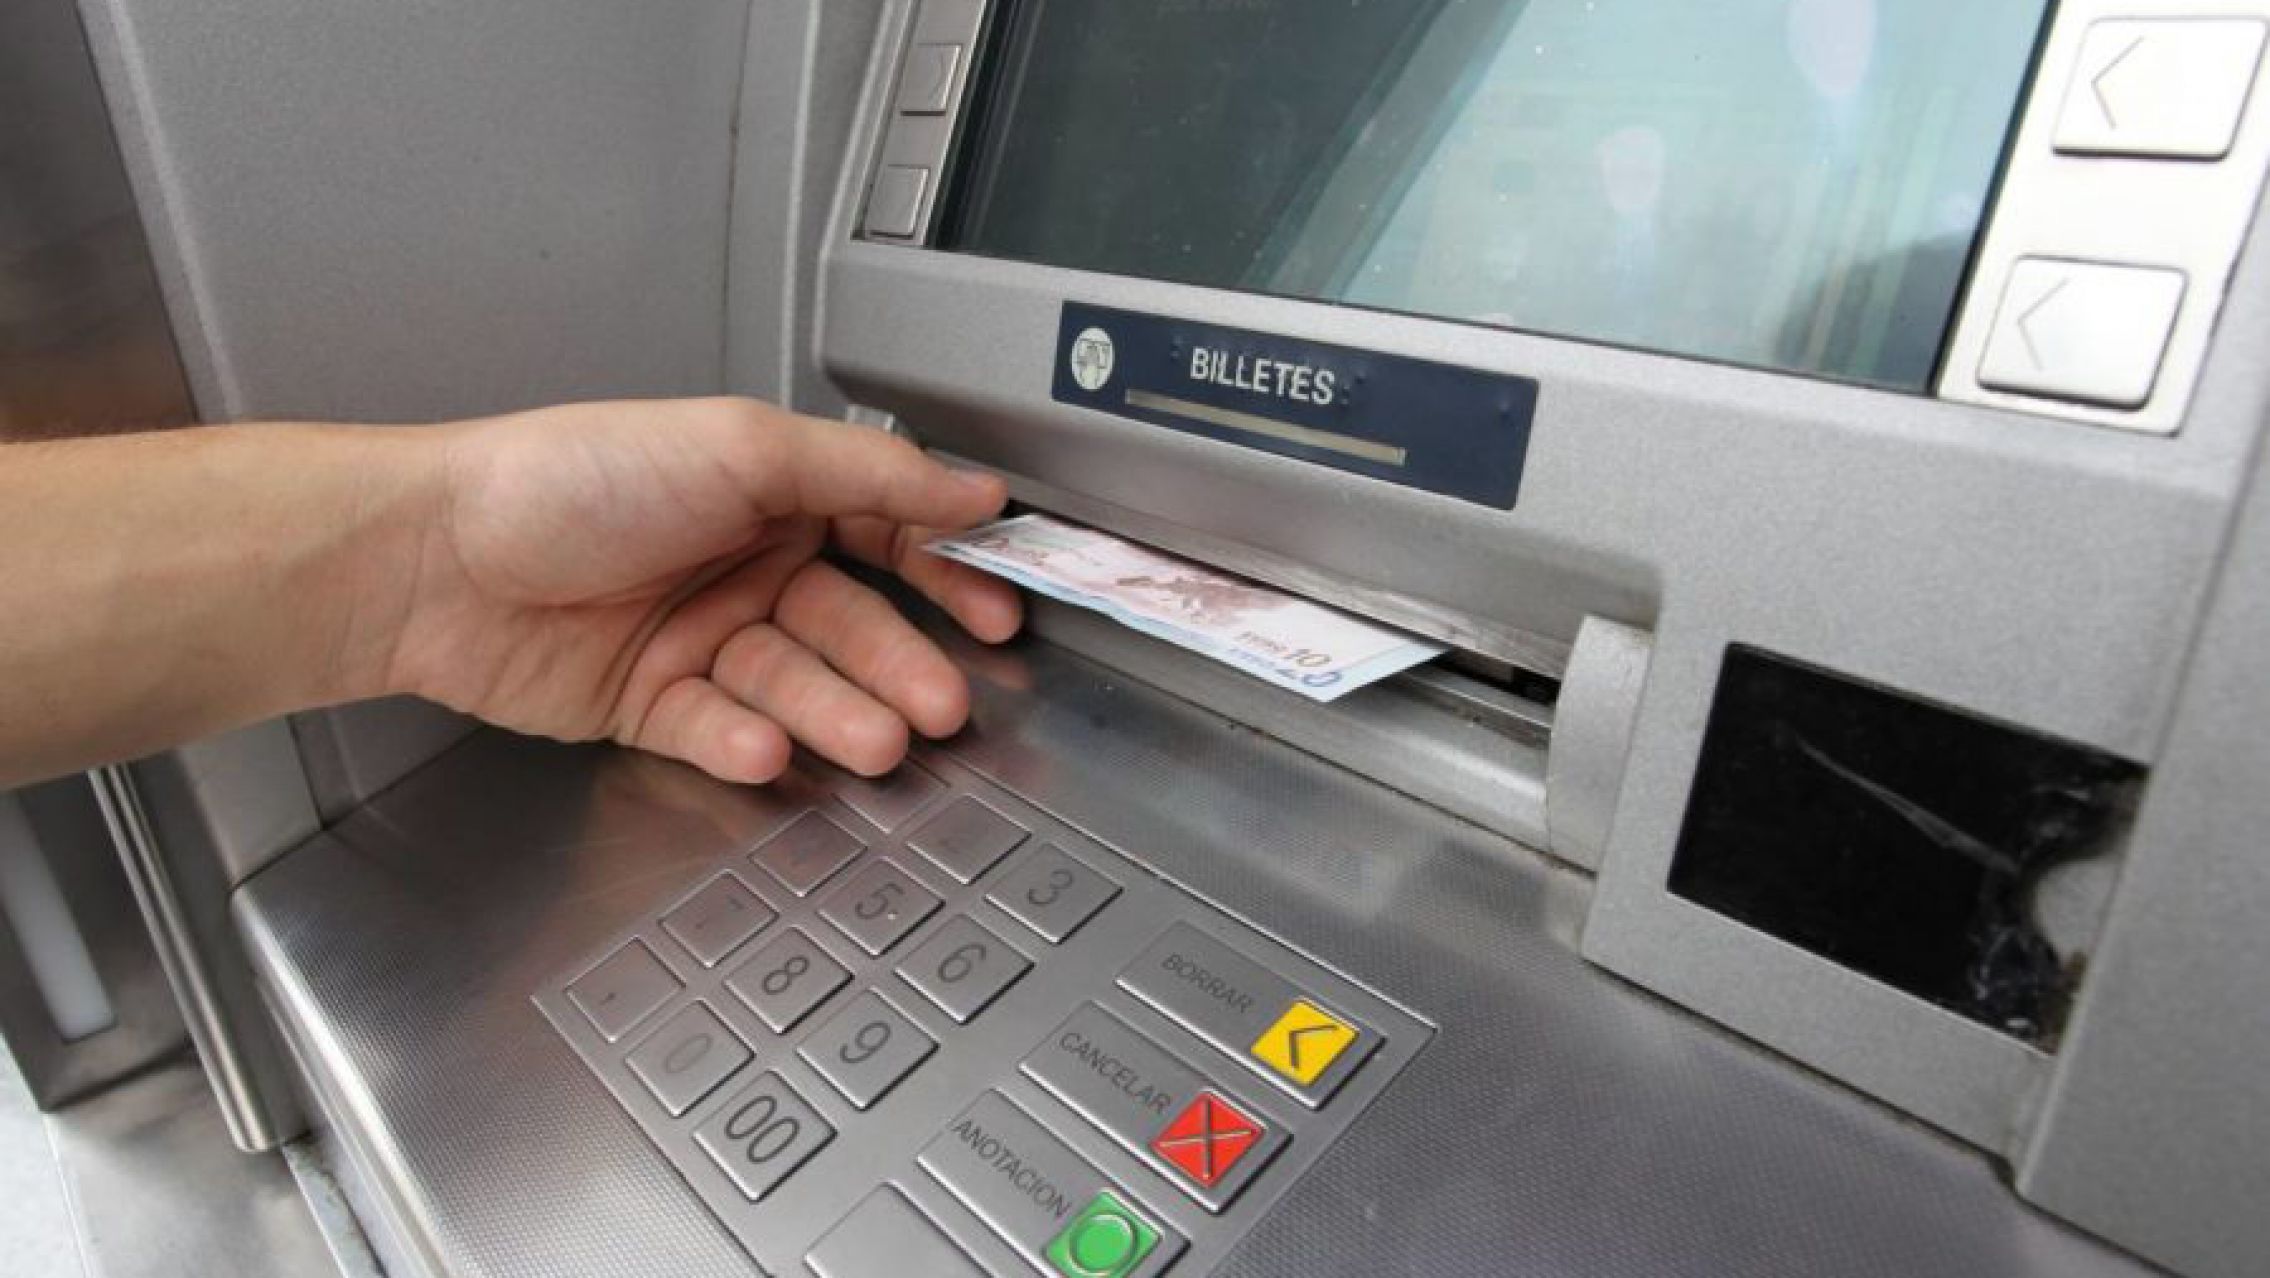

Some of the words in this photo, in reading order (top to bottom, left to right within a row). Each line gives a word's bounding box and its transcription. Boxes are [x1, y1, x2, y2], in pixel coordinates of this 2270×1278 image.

[1191, 349, 1336, 405] BILLETES
[855, 882, 904, 920] 5
[1027, 868, 1073, 905] 3
[761, 956, 809, 995] 8
[938, 943, 985, 983] 6
[1162, 954, 1253, 1014] BORRAR
[666, 1032, 711, 1074] 0
[839, 1022, 892, 1065] 9
[1059, 1031, 1172, 1115] CANCELAR
[725, 1095, 799, 1163] 00
[953, 1118, 1072, 1219] ANOTACION
